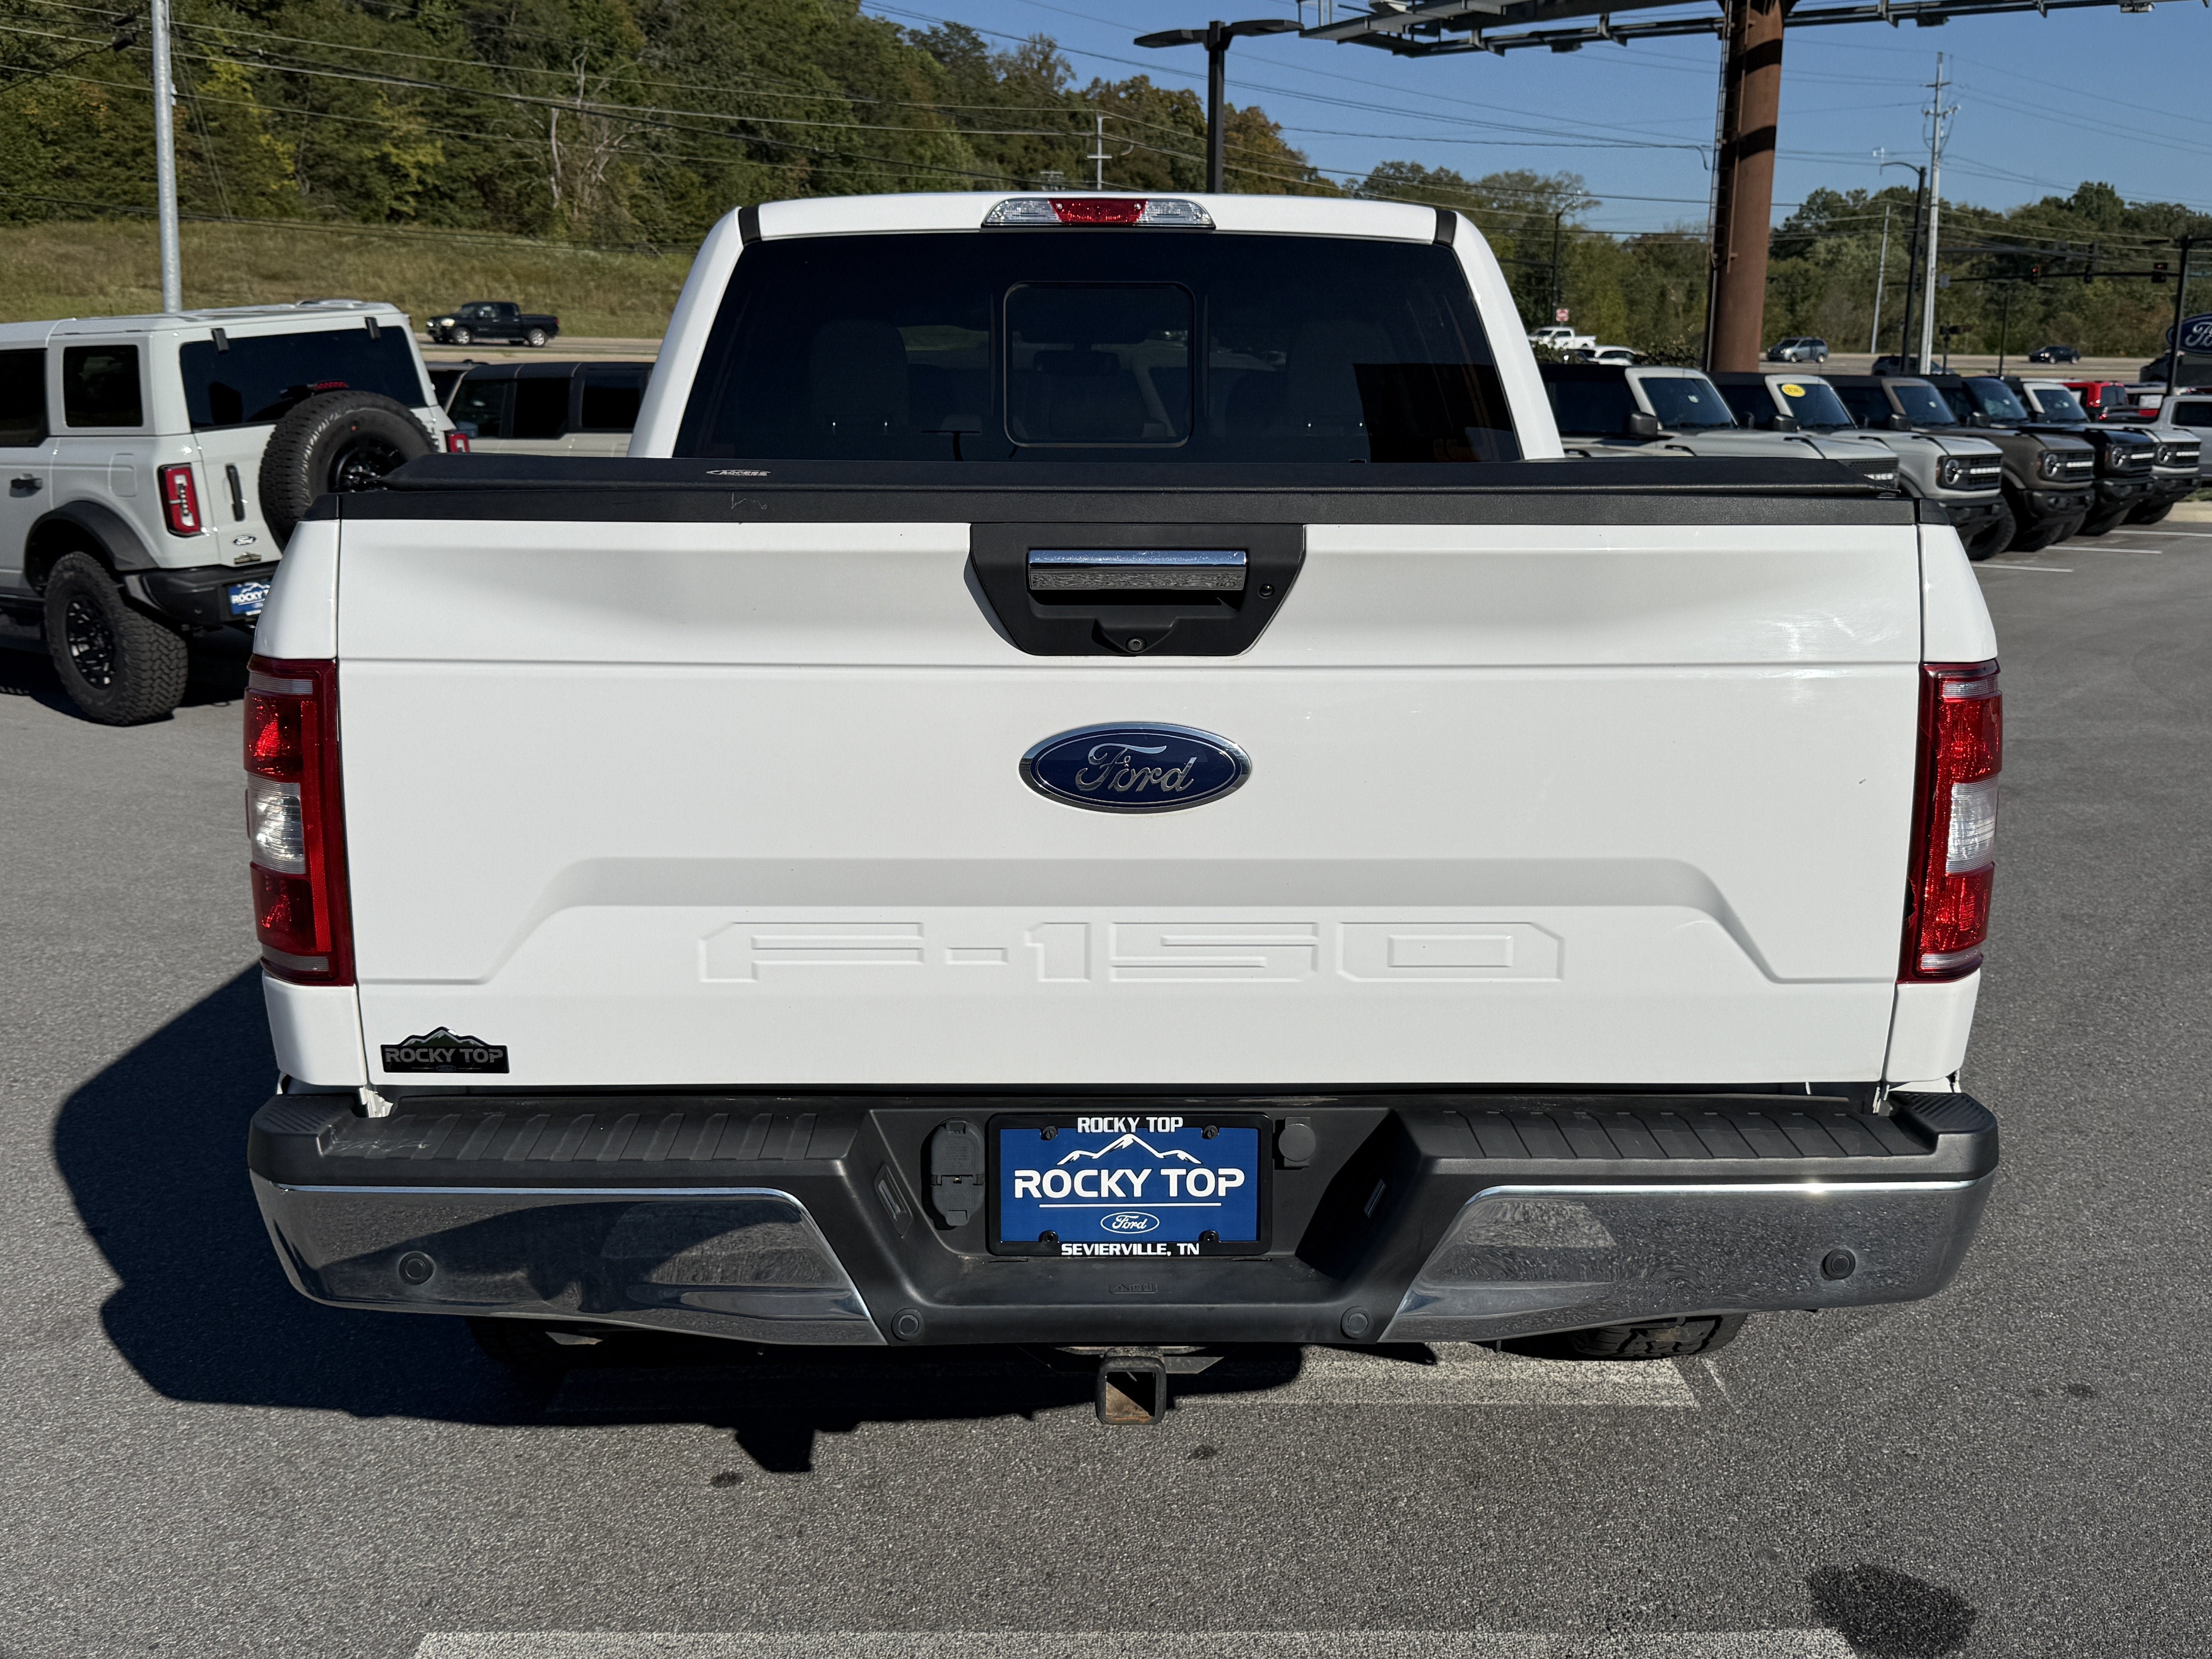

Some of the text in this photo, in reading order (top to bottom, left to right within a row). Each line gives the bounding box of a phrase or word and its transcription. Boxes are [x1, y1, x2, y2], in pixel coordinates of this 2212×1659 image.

[2185, 321, 2212, 347] Fo
[231, 591, 263, 604] ROCKY
[1075, 743, 1197, 792] Ford
[698, 922, 1565, 983] F-150
[385, 1048, 503, 1063] ROCKY TOP
[1077, 1117, 1183, 1133] ROCKY TOP
[1014, 1168, 1245, 1198] ROCKY TOP
[1111, 1214, 1147, 1230] Ford
[1061, 1243, 1200, 1256] SEVIERVILLE, TN
